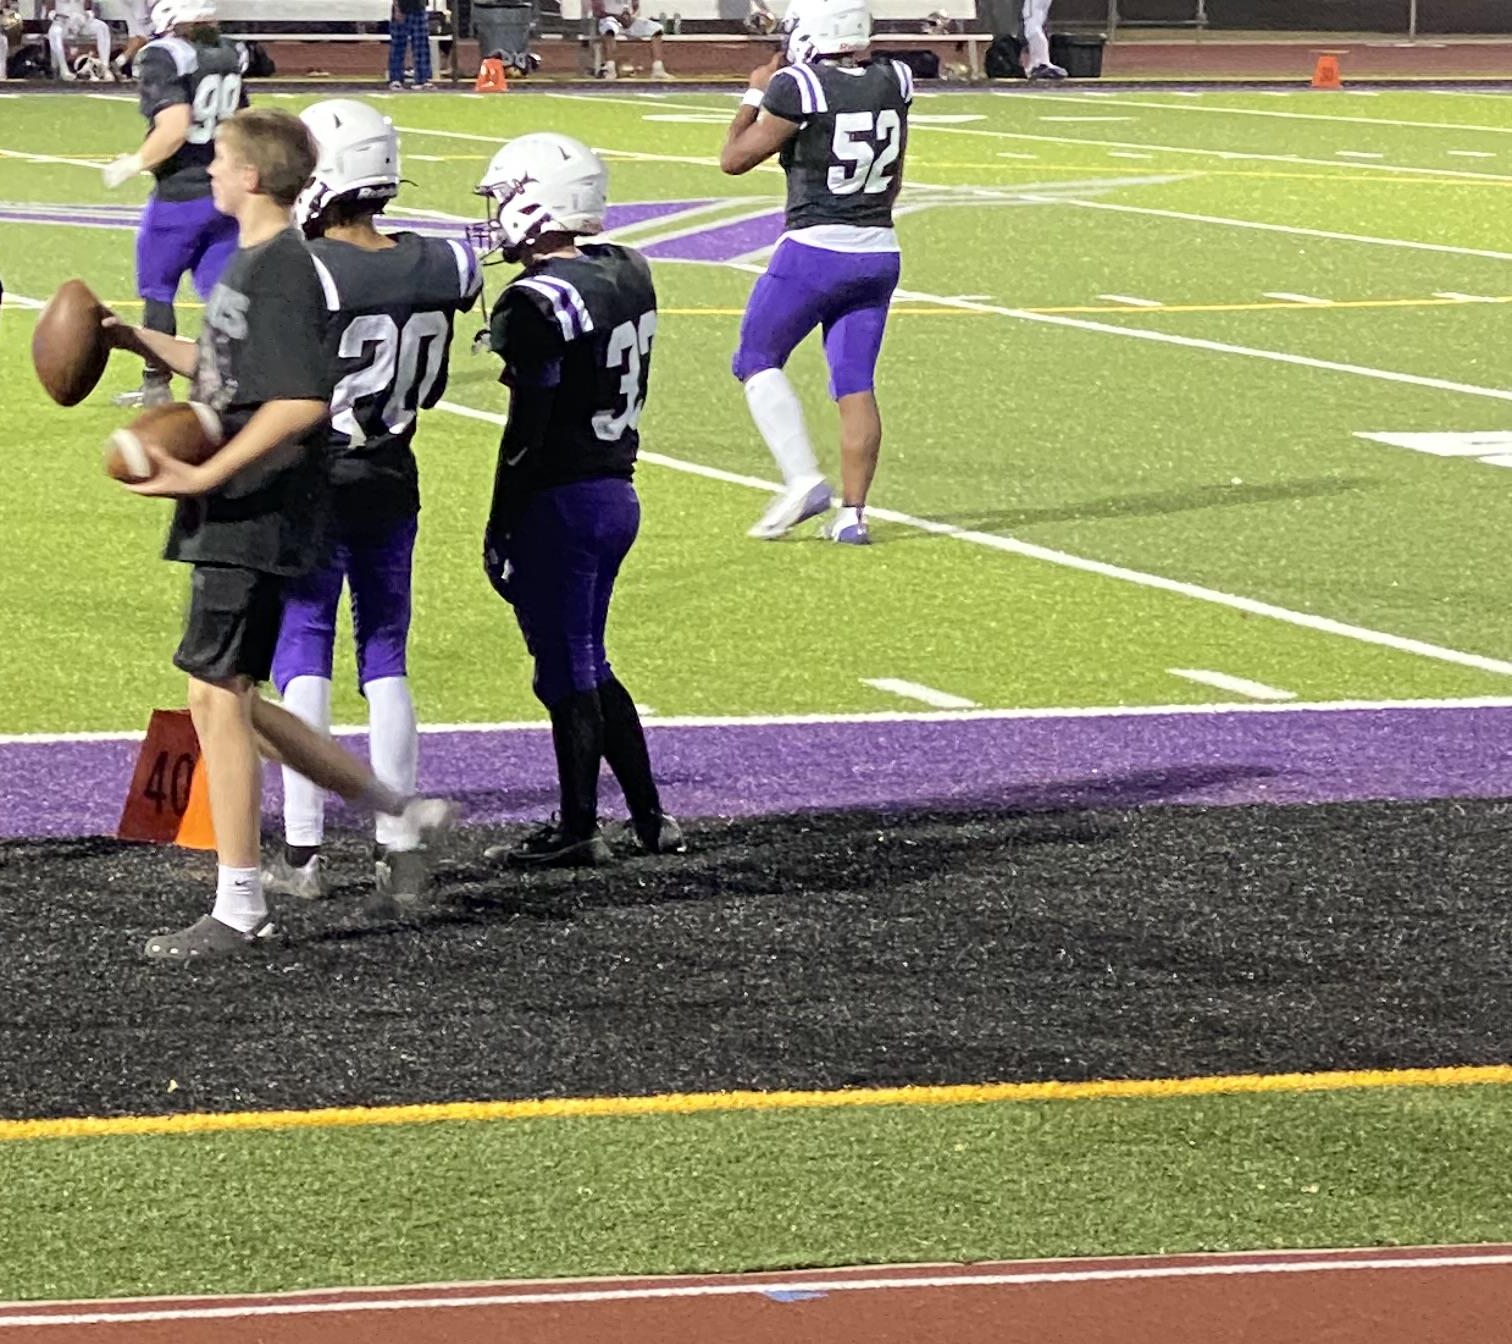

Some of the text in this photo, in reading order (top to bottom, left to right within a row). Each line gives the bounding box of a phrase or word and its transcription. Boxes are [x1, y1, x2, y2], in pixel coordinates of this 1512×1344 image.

[827, 109, 901, 195] 52
[329, 311, 449, 449] 20
[144, 750, 195, 817] 40
